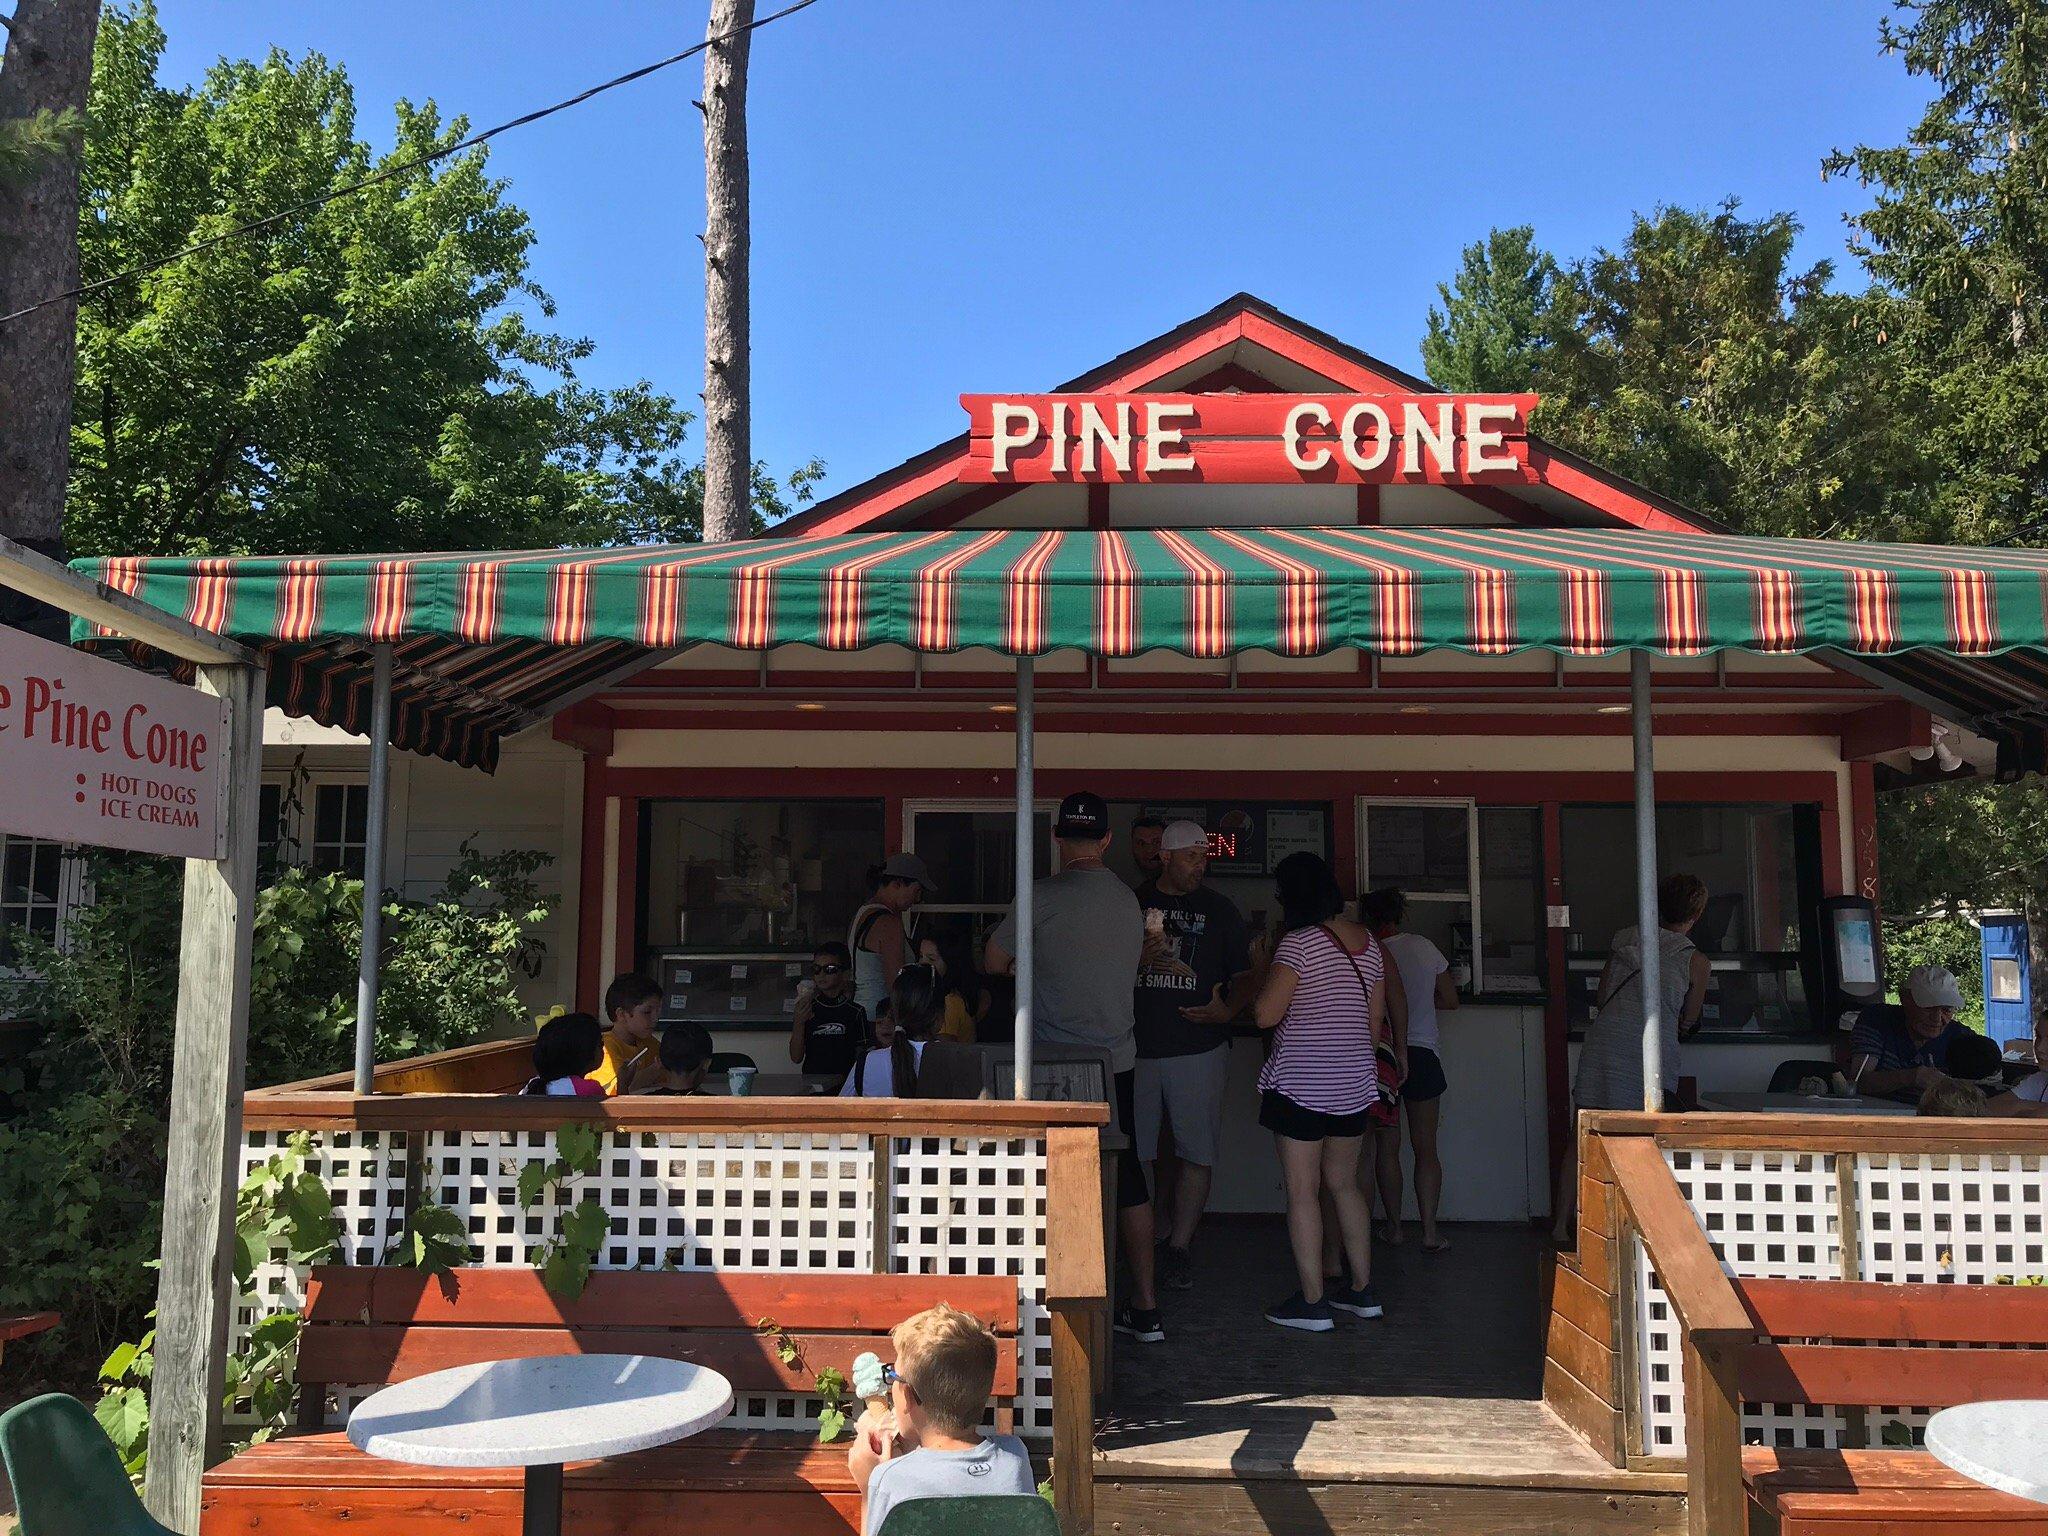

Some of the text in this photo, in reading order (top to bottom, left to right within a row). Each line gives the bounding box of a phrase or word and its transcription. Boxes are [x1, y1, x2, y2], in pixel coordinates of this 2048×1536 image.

[991, 402, 1518, 474] PINE CONE
[24, 676, 111, 754] Pine
[123, 703, 207, 772] Cone
[101, 772, 197, 805] HOT DOGS
[100, 798, 200, 828] ICE CREAM
[1205, 832, 1236, 858] EN
[1146, 974, 1196, 991] SMALLS!
